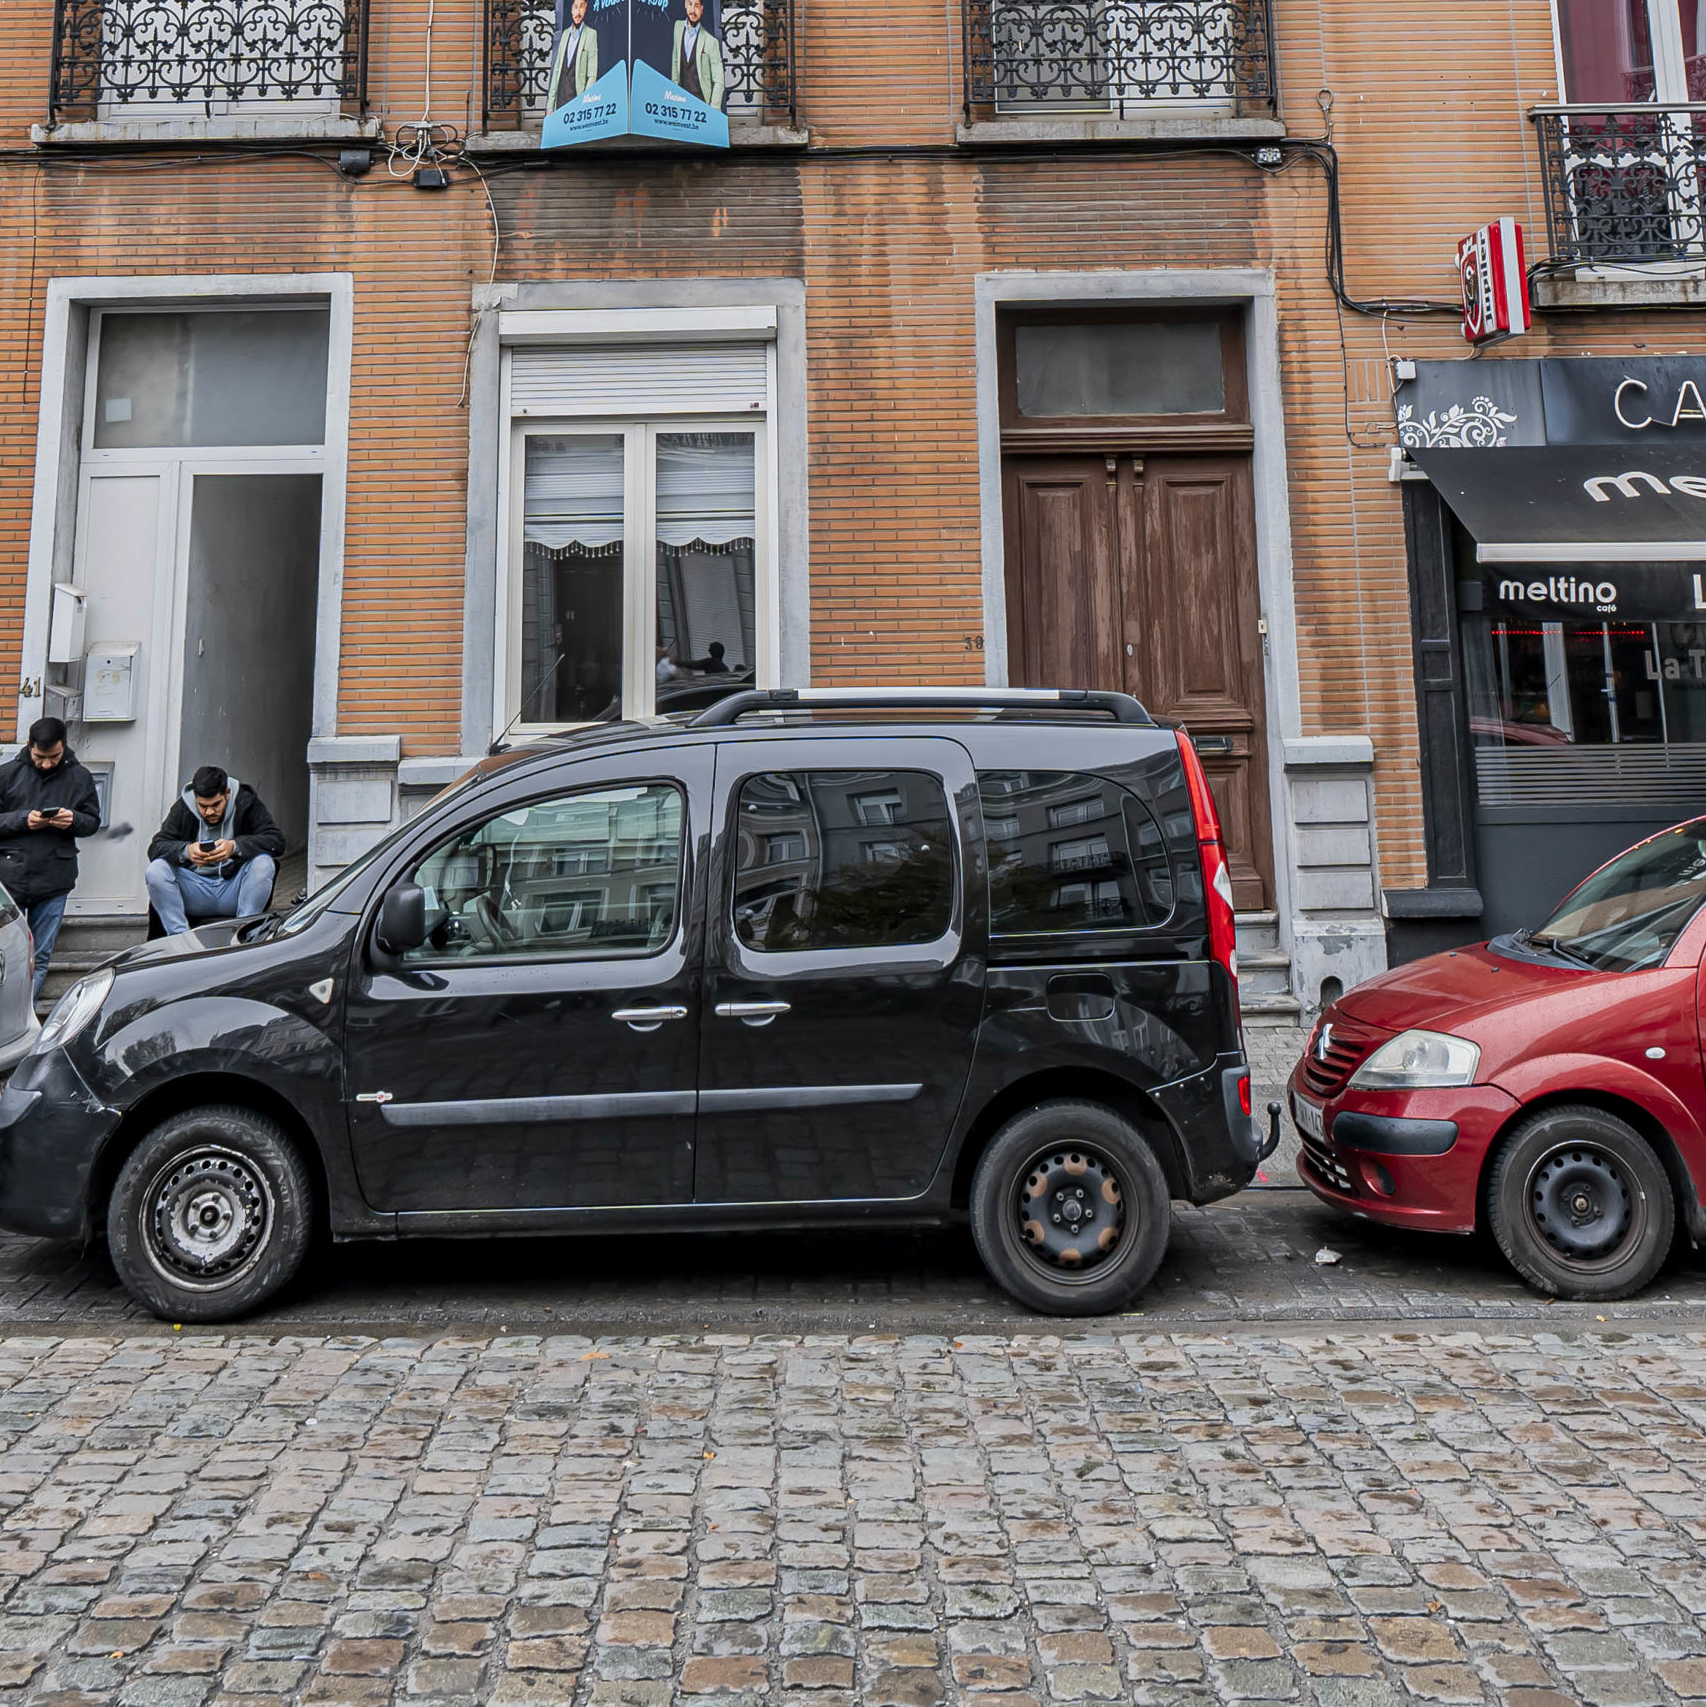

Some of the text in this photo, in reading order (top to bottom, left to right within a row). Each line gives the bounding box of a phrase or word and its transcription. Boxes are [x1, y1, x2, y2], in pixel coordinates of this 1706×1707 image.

[563, 103, 617, 125] 02 315 77 22
[645, 102, 707, 123] 02 315 77 22
[1499, 576, 1617, 604] meltino
[1596, 603, 1617, 613] café
[1645, 649, 1681, 680] La
[20, 676, 41, 698] 41
